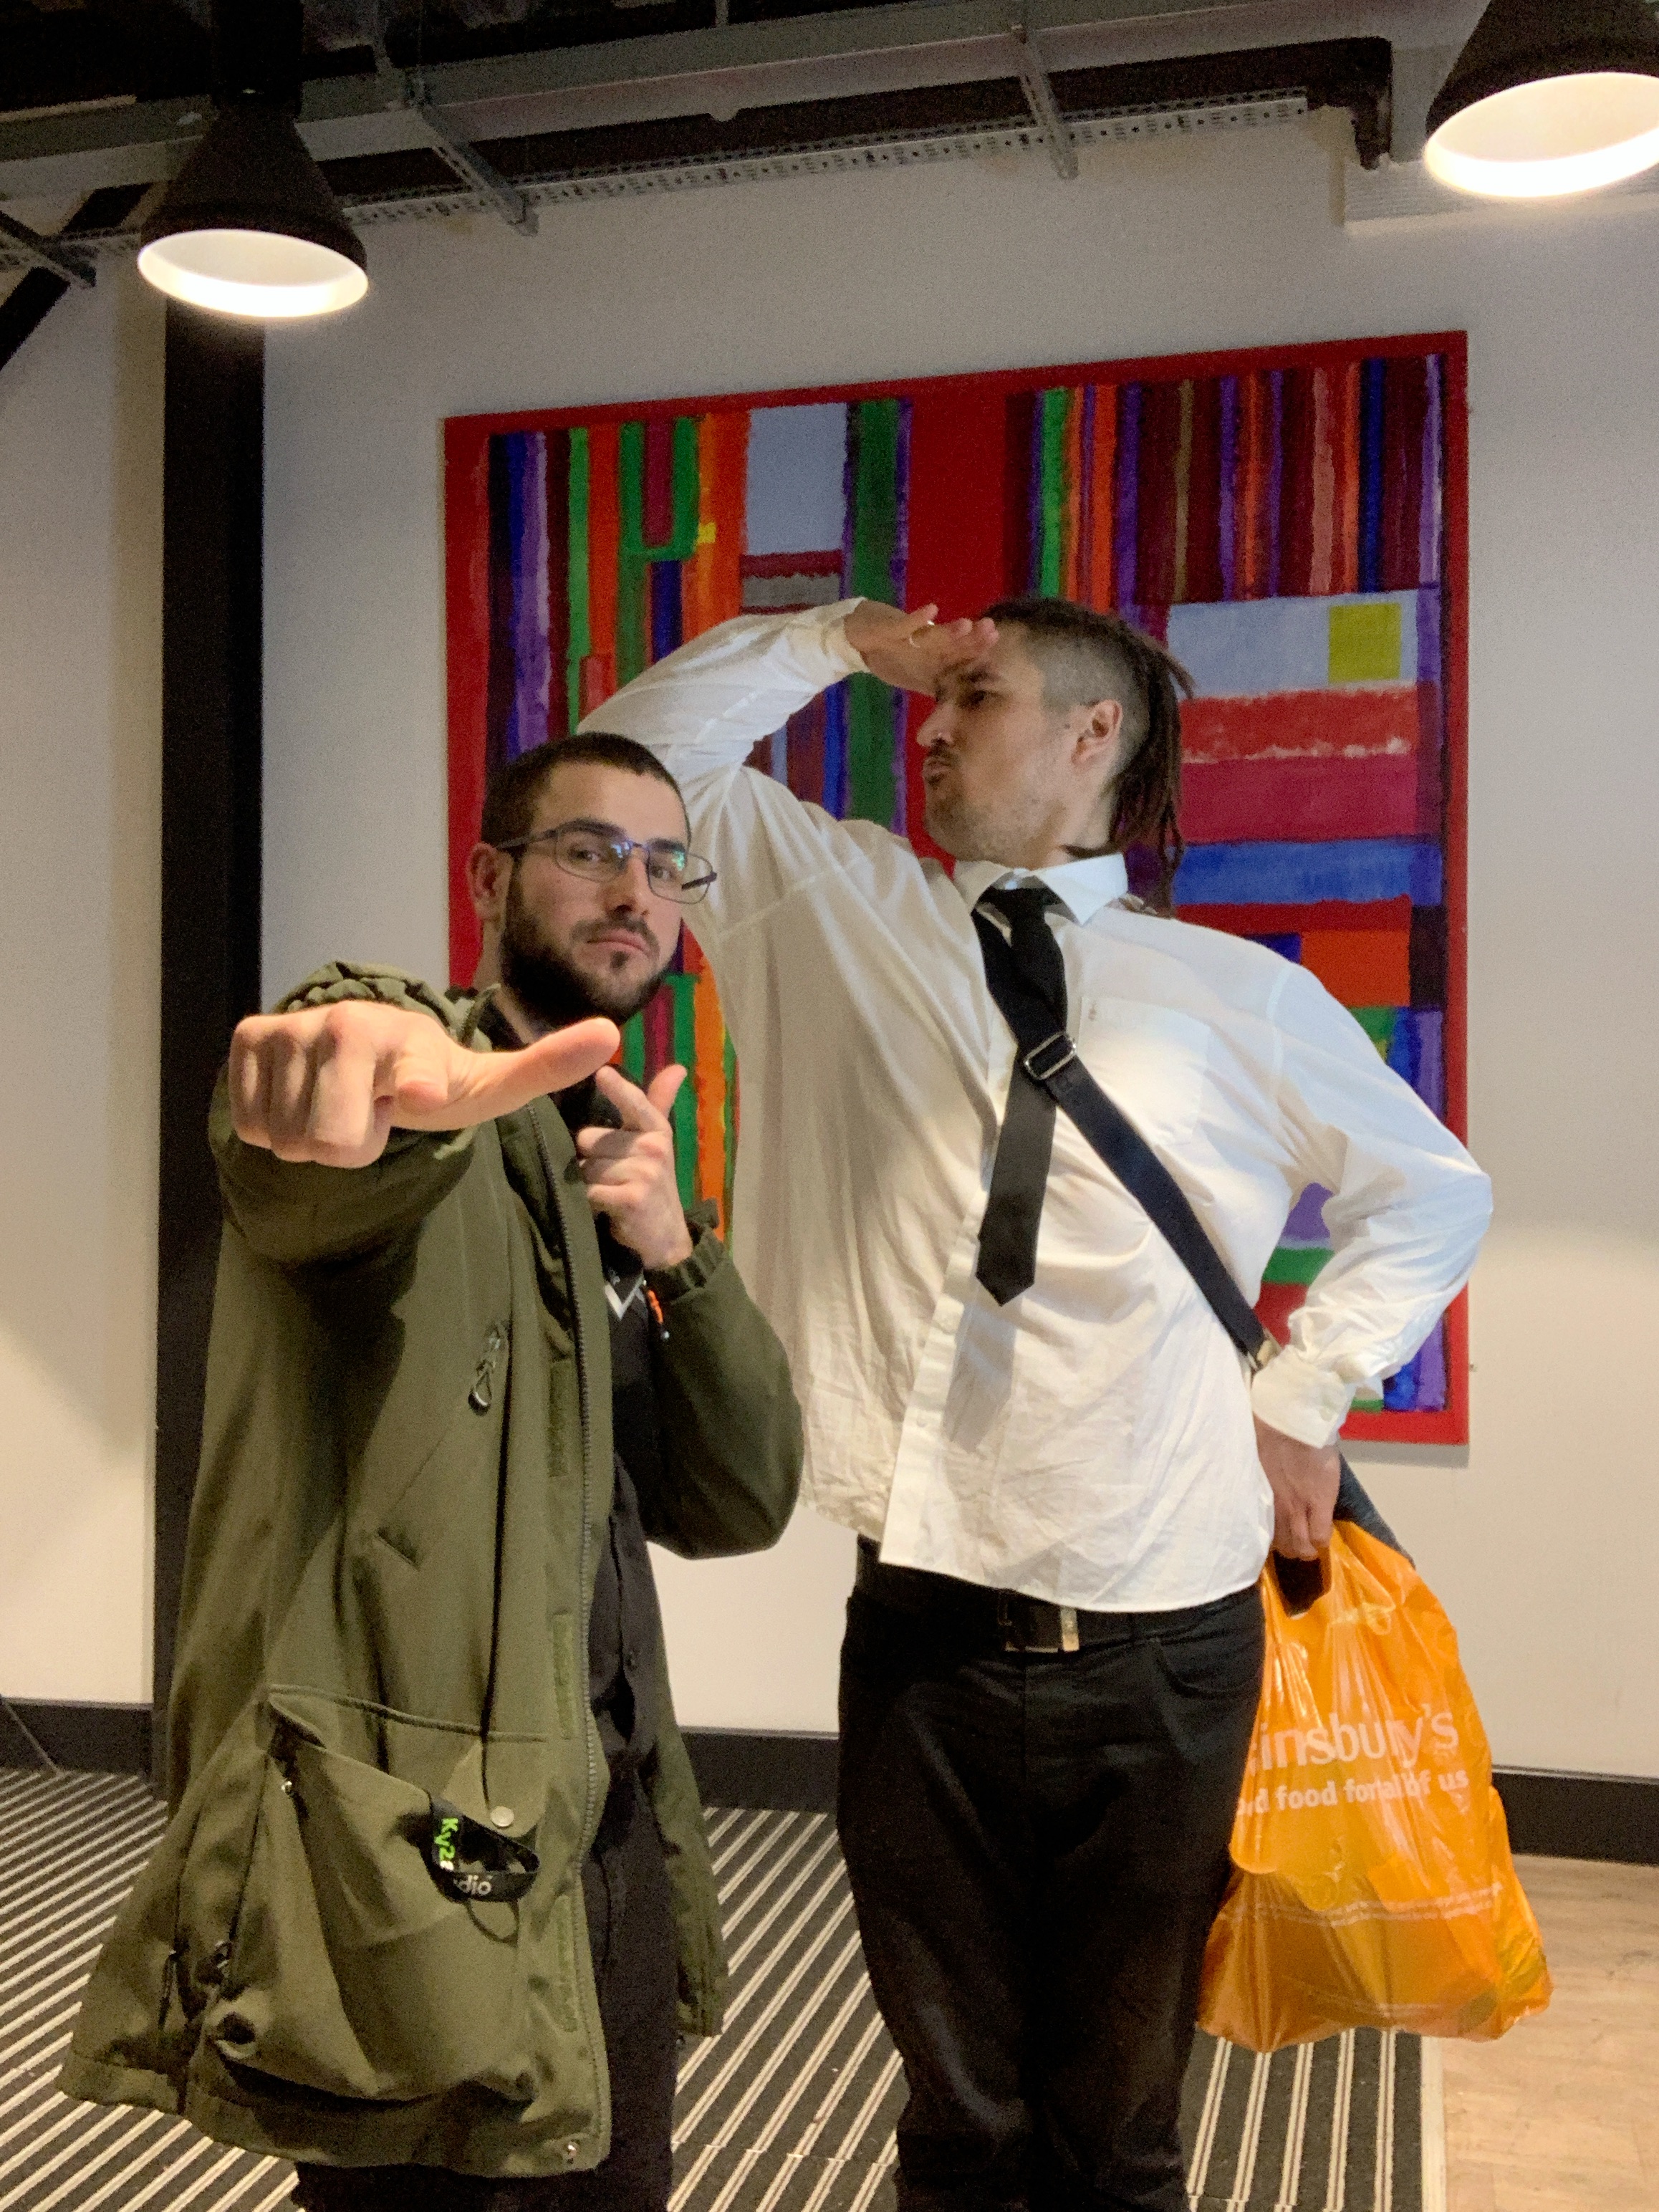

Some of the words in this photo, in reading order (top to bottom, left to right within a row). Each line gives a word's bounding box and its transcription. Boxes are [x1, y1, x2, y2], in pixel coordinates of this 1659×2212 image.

[1248, 1703, 1459, 1776] insbury's
[1276, 1780, 1337, 1811] food
[1438, 1770, 1469, 1791] us
[453, 1874, 491, 1895] dio
